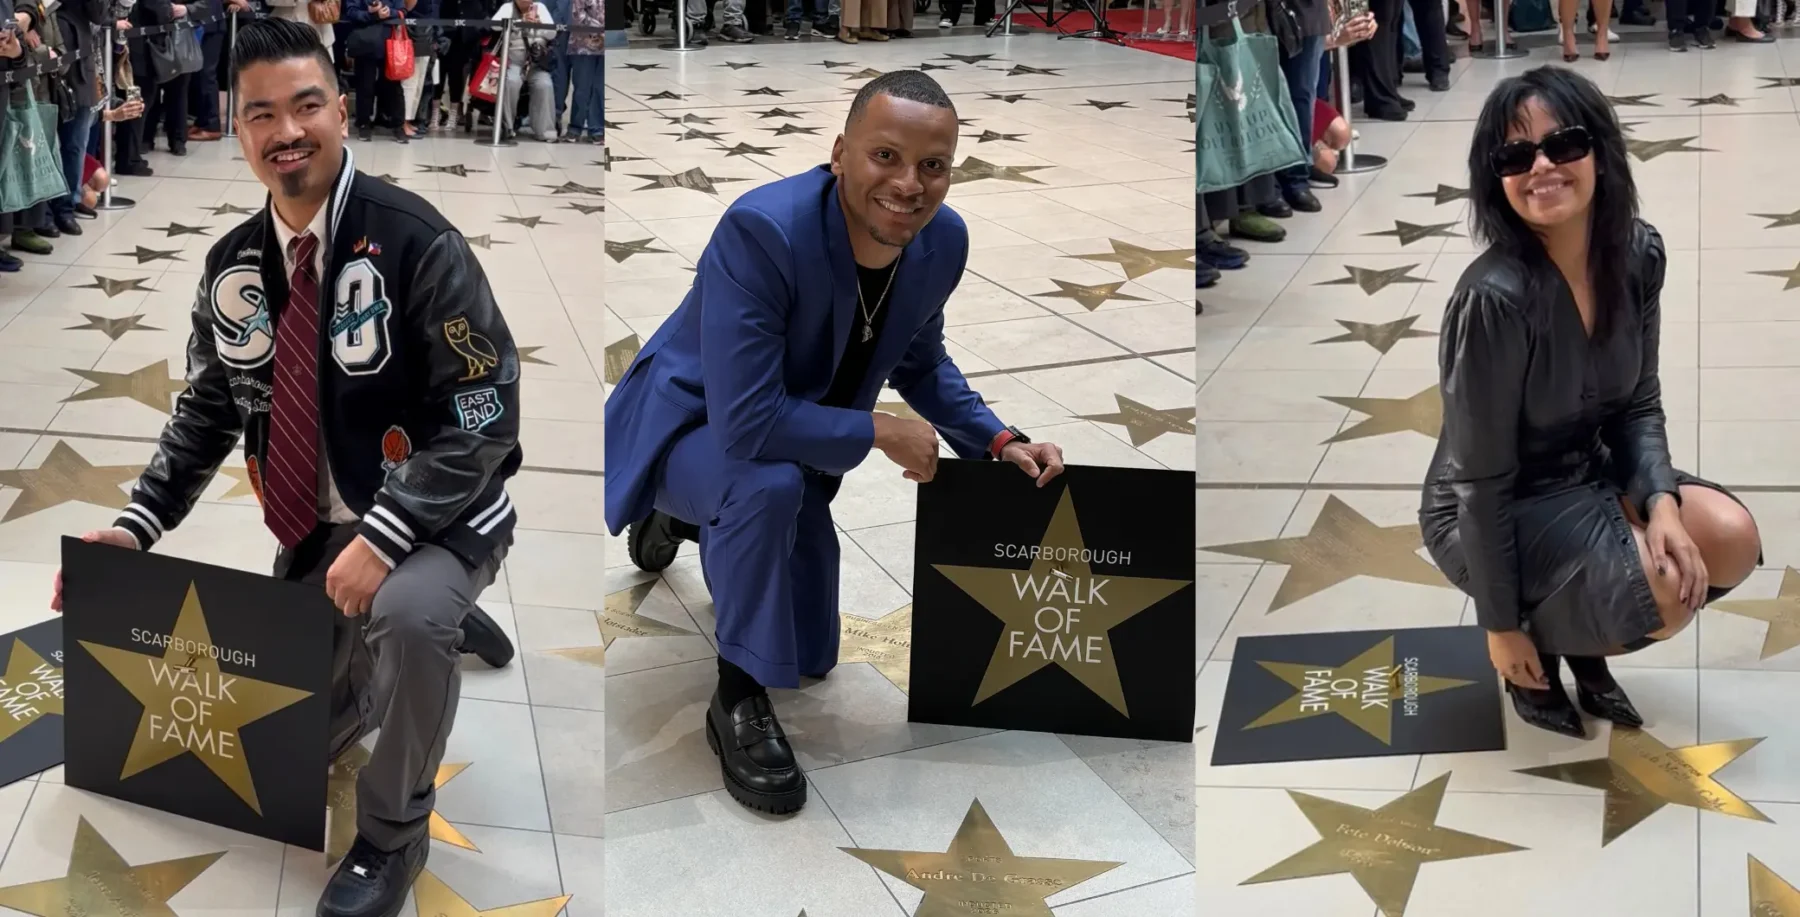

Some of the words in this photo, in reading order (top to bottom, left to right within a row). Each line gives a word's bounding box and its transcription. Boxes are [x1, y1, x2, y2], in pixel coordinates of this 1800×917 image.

[460, 391, 493, 409] EAST
[464, 402, 496, 429] END
[994, 543, 1132, 565] SCARBOROUGH
[1011, 572, 1110, 606] WALK
[844, 627, 878, 640] Mike
[1034, 606, 1081, 634] OF
[131, 627, 256, 668] SCARBOROUGH
[1009, 630, 1103, 663] FAME
[15, 682, 51, 701] OF
[29, 663, 64, 699] WAL
[147, 658, 237, 704] WALK
[1299, 670, 1332, 713] FAME
[1330, 678, 1358, 699] OF
[1361, 665, 1390, 710] WALK
[1403, 657, 1419, 717] SCARBOROUGH
[171, 696, 213, 726] OF
[150, 714, 235, 759] FAME
[905, 867, 963, 882] Andre
[971, 872, 997, 883] De
